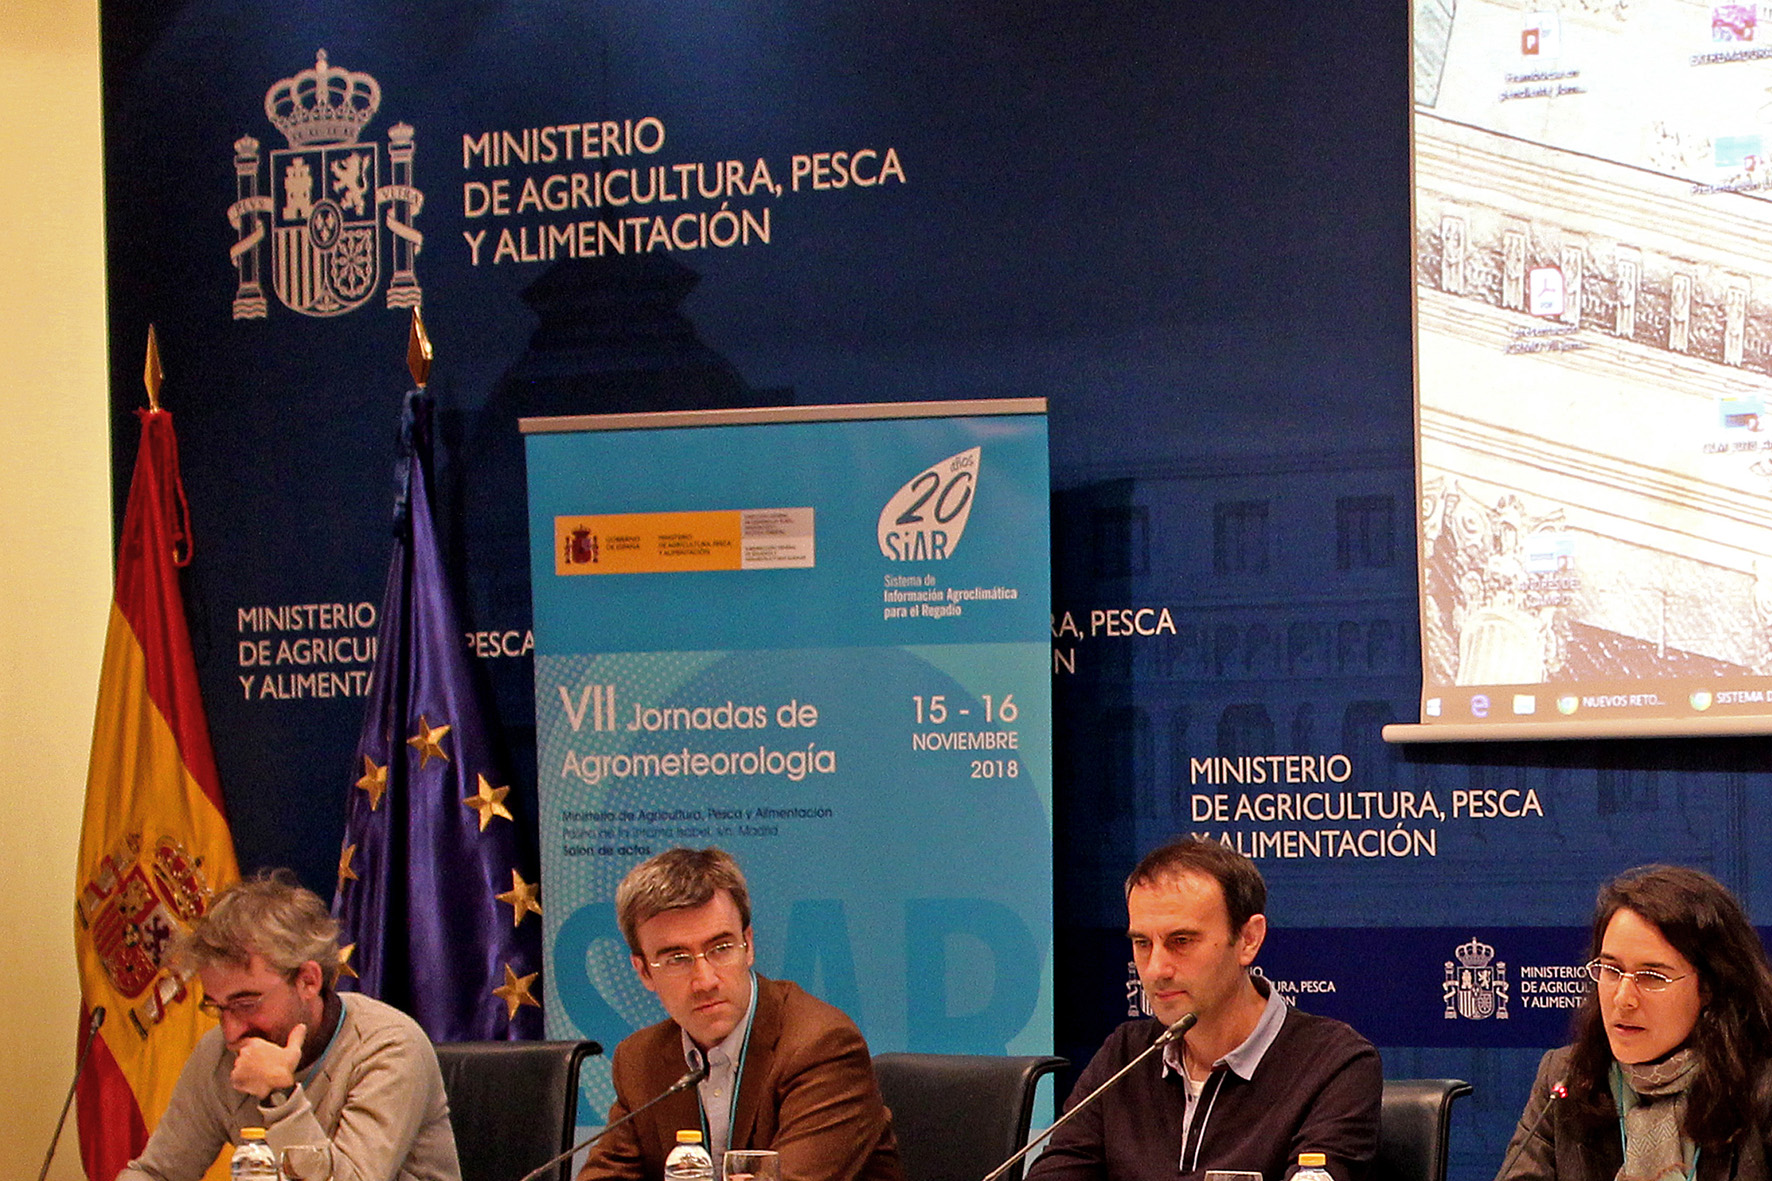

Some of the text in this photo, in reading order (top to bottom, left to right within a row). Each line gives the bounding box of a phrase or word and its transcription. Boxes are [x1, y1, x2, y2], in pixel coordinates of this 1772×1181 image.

[462, 116, 666, 169] MINISTERIO
[463, 179, 511, 219] DE
[517, 157, 784, 214] AGRICULTURA,
[791, 147, 907, 193] PESCA
[463, 201, 771, 266] Y ALIMENTACIÓN
[895, 471, 972, 526] 20
[884, 573, 936, 587] Sistema de
[884, 586, 1018, 603] Información Agroclimática
[238, 602, 376, 632] MINISTERIO
[884, 606, 907, 620] para
[909, 604, 920, 618] el
[1090, 607, 1177, 637] PESCA
[238, 640, 271, 666] DE
[238, 671, 374, 700] Y ALIMENT
[1716, 692, 1764, 704] SISTEMA
[558, 685, 818, 732] VII Jornadas de
[912, 694, 947, 724] 15
[981, 693, 1019, 724] 16
[1582, 694, 1627, 707] NUEVOS
[912, 730, 1019, 752] NOVIEMBRE
[561, 743, 837, 786] Agrometeorología
[970, 760, 1019, 780] 2018
[1190, 754, 1352, 785] MINISTERIO
[708, 808, 742, 820] Pesca
[1191, 789, 1544, 822] DE AGRICULTURA, PESCA
[1220, 823, 1437, 858] ALIMENTACIÓN
[1521, 966, 1587, 978] MINISTERIO
[1300, 981, 1336, 994] PESCA
[1521, 981, 1538, 993] DE
[1521, 996, 1588, 1008] Y ALIMENT
